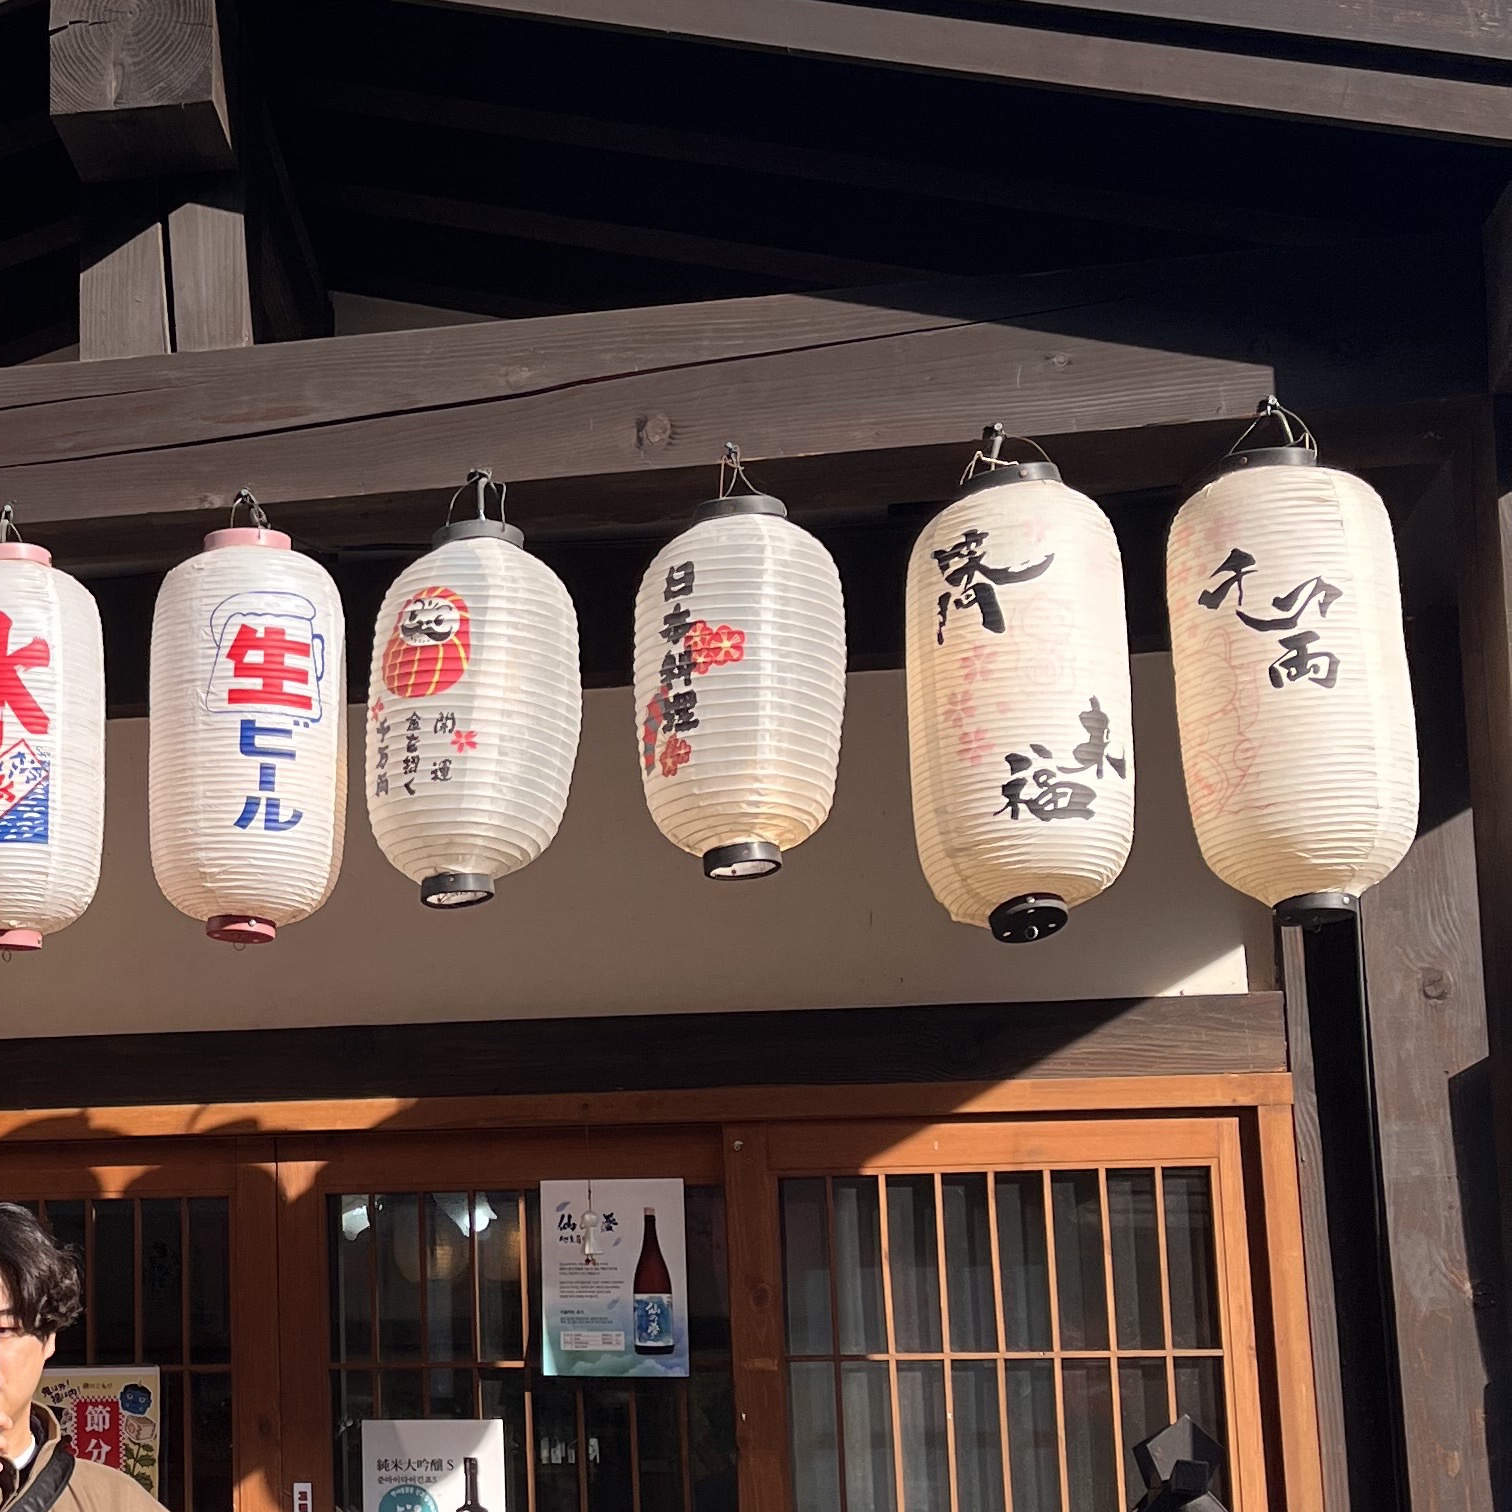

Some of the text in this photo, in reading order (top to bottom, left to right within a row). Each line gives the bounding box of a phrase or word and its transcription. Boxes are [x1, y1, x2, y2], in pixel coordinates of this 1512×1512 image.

[225, 623, 313, 832] 生ビール
[661, 561, 700, 734] 日本料理
[431, 711, 456, 781] 開運
